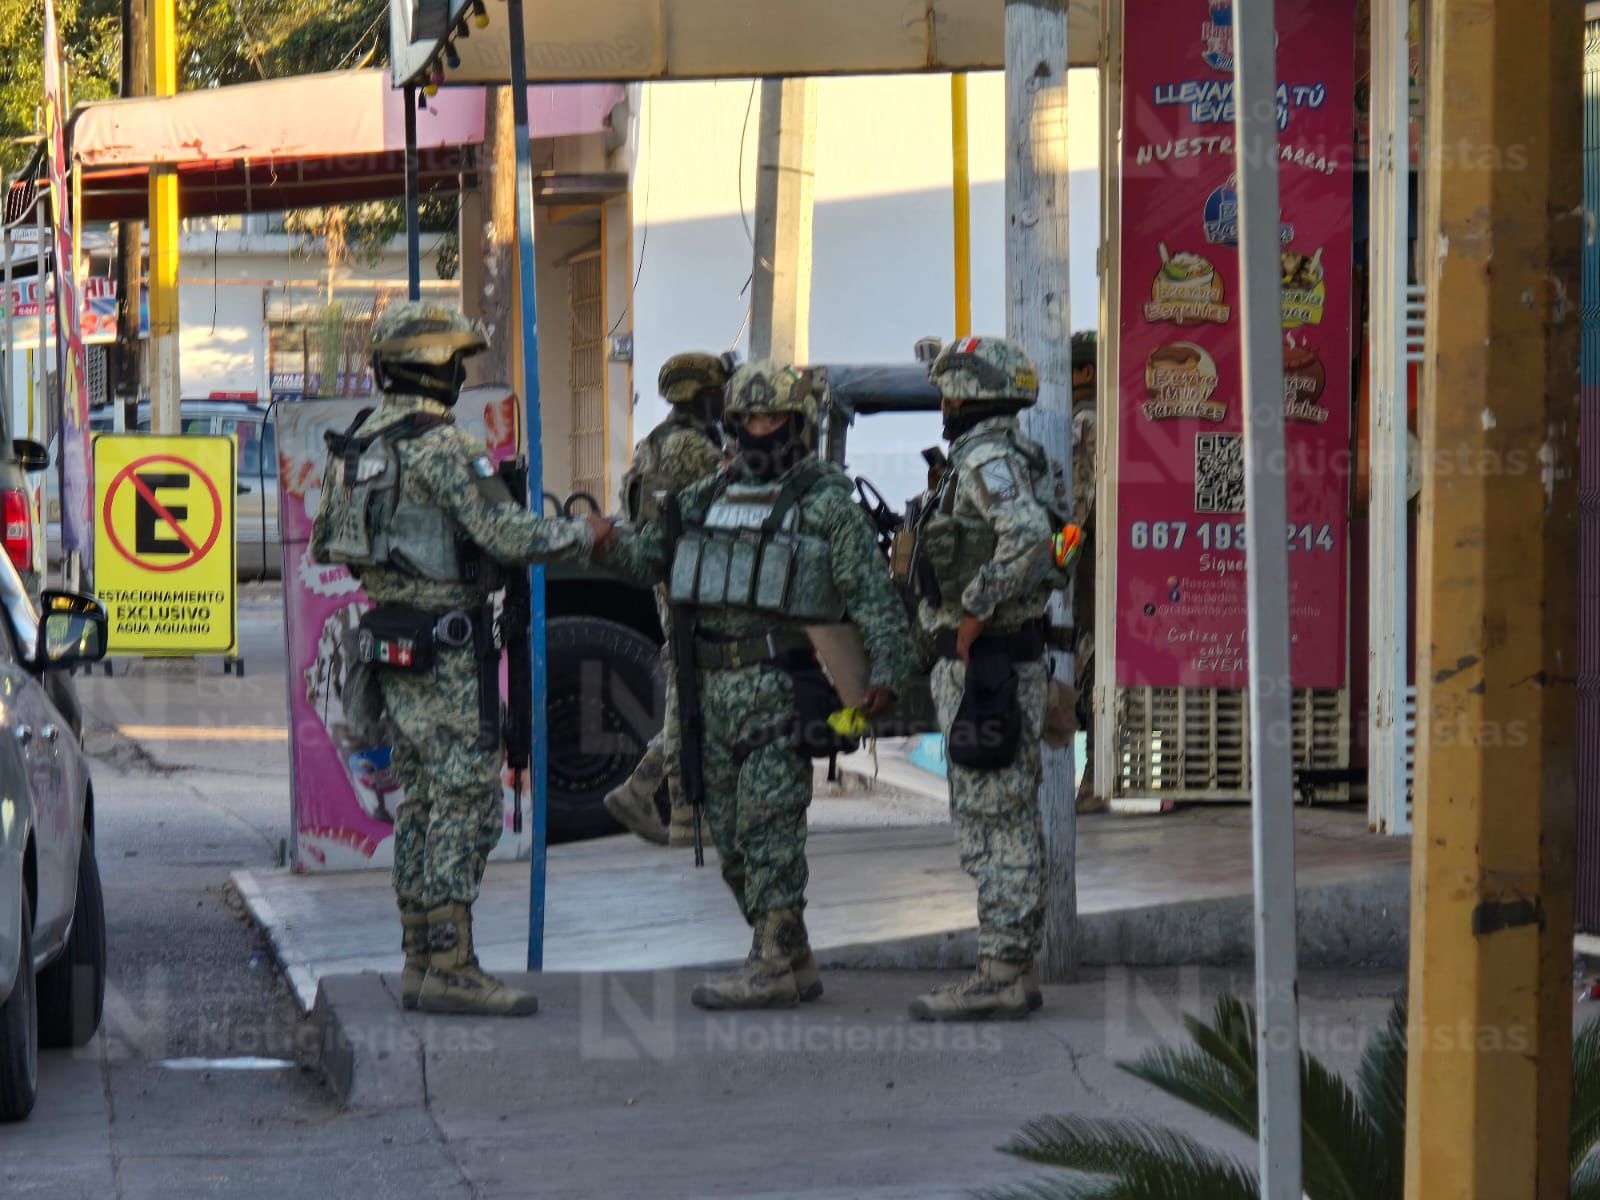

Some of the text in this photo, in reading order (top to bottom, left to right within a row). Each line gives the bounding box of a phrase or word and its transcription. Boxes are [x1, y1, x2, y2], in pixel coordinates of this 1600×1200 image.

[1131, 521, 1187, 549] 667
[98, 590, 225, 603] ESTACIONAMIENTO
[117, 605, 210, 620] EXCLUSIVO
[116, 622, 150, 633] AGUA
